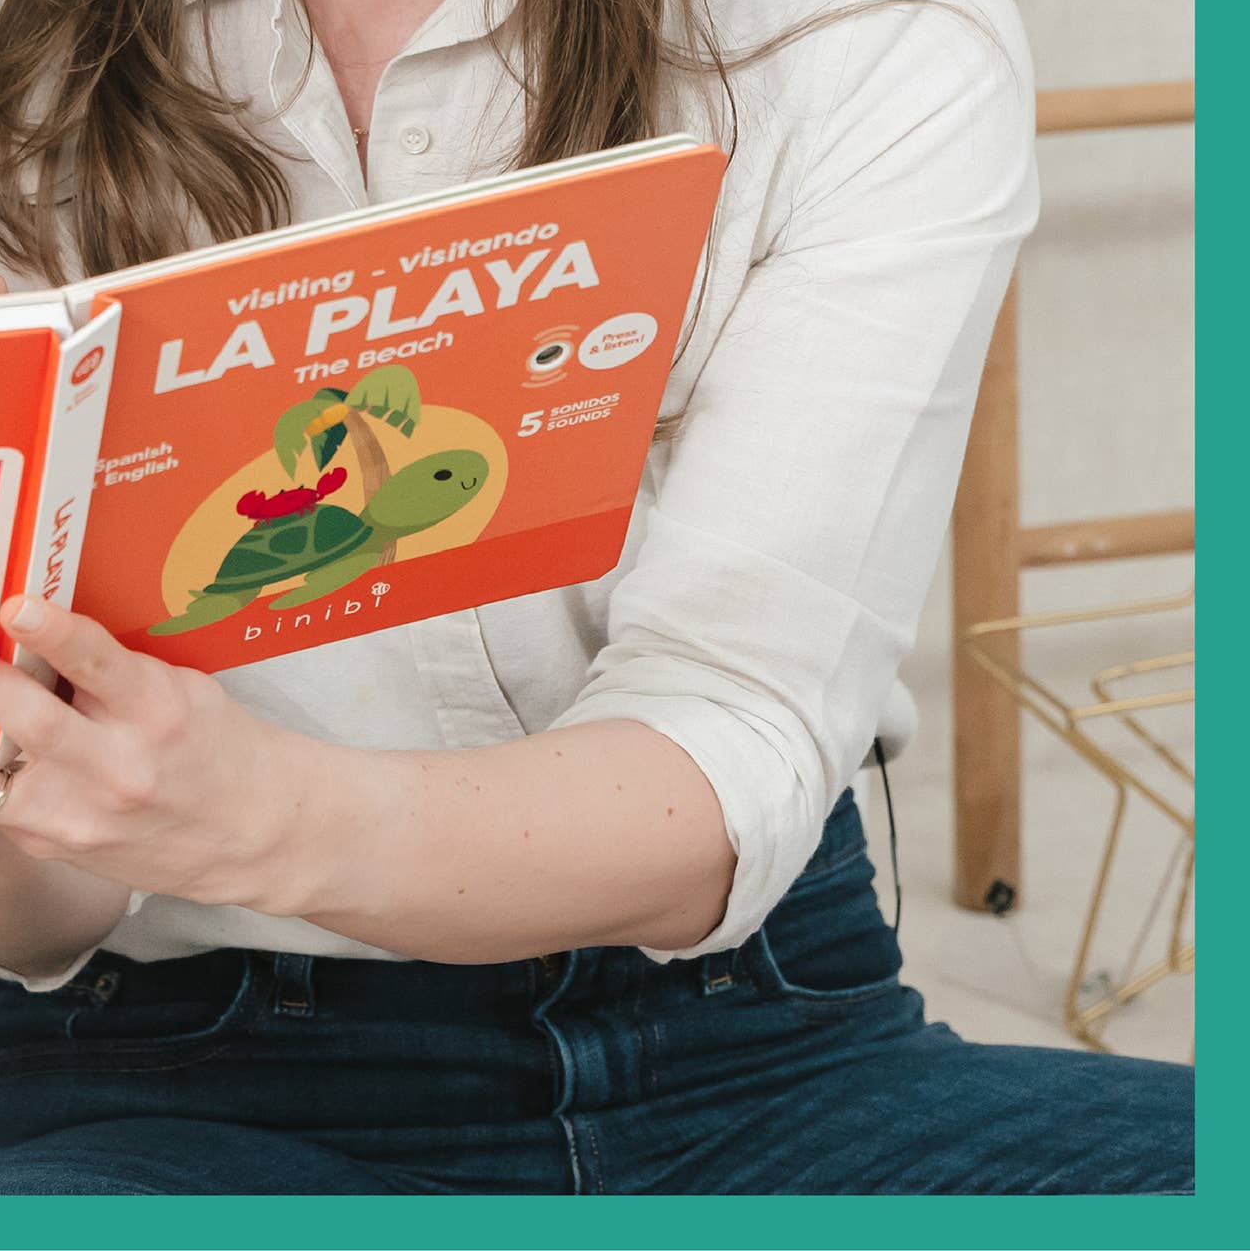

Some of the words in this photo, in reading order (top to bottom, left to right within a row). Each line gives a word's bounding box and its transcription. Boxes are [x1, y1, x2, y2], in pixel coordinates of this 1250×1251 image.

[228, 270, 355, 316] visiting
[399, 222, 560, 274] visitando
[154, 319, 275, 395] LA
[304, 240, 600, 356] PLAYA
[602, 329, 639, 343] Press
[294, 358, 349, 384] The
[357, 330, 454, 369] Beach
[547, 408, 612, 431] SOUNDS
[550, 392, 621, 417] SONIDOS
[517, 409, 545, 438] 5
[104, 457, 180, 487] English
[244, 581, 392, 641] binibi
